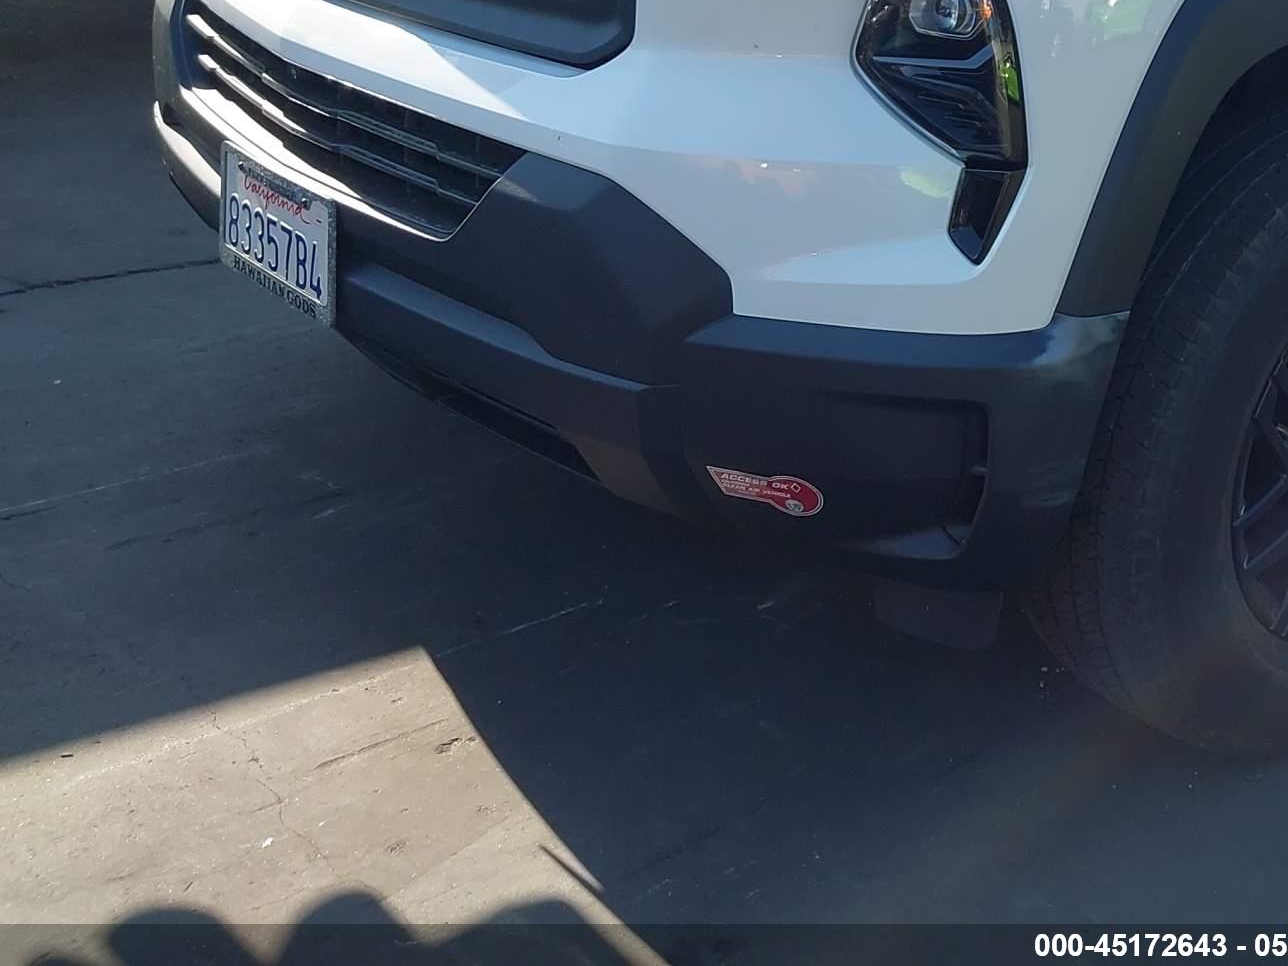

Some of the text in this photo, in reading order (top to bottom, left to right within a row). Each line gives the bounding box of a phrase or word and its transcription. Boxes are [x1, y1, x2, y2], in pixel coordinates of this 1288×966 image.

[228, 193, 323, 302] 83357B4
[233, 255, 317, 318] HAWAIIAN GODS
[720, 472, 768, 486] ACCESS
[771, 481, 790, 491] OK
